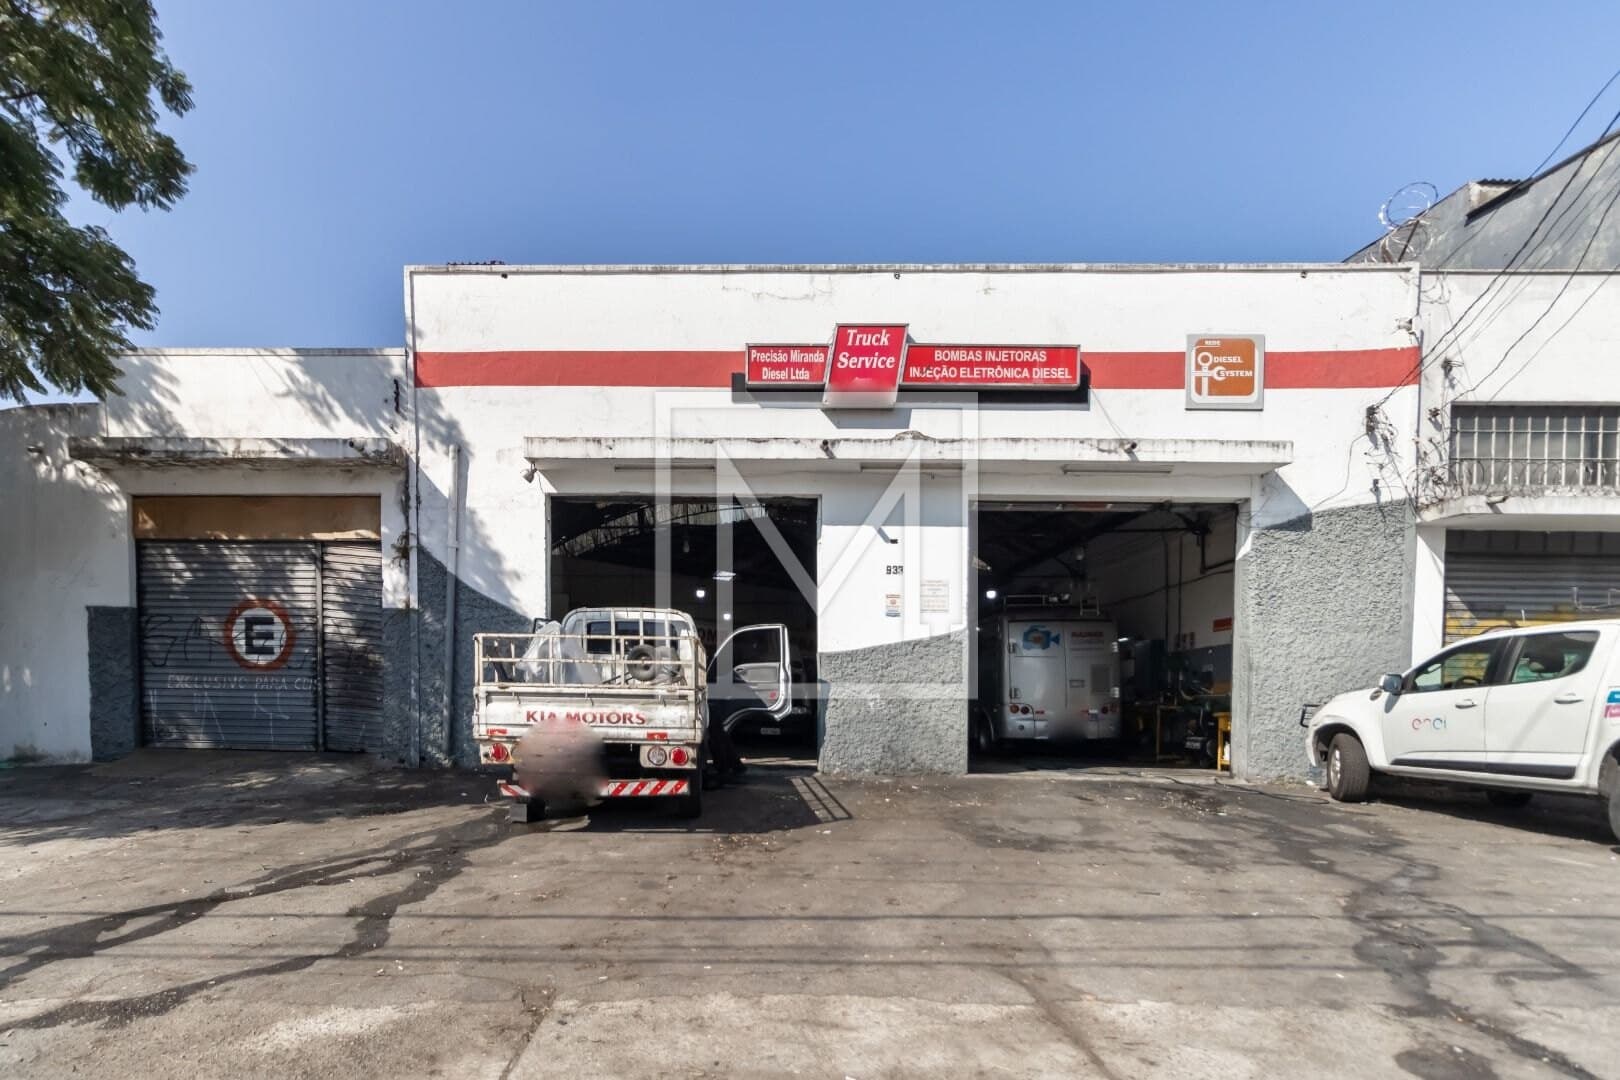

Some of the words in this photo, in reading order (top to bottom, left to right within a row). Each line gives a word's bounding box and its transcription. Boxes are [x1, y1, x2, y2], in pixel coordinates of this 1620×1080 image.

[846, 328, 890, 346] Truck
[751, 349, 788, 363] Precisão
[790, 350, 825, 363] Miranda
[837, 351, 896, 369] Service
[934, 350, 982, 362] BOMBAS
[985, 350, 1047, 362] INJETORAS
[1213, 355, 1244, 363] DIESEL
[762, 367, 788, 380] Diesel
[790, 367, 810, 380] Ltda
[909, 365, 957, 380] INJEÇÃO
[959, 365, 1029, 379] ELETRÔNICA
[1032, 367, 1072, 379] DIESEL
[245, 616, 275, 655] E
[565, 711, 646, 725] MOTORS
